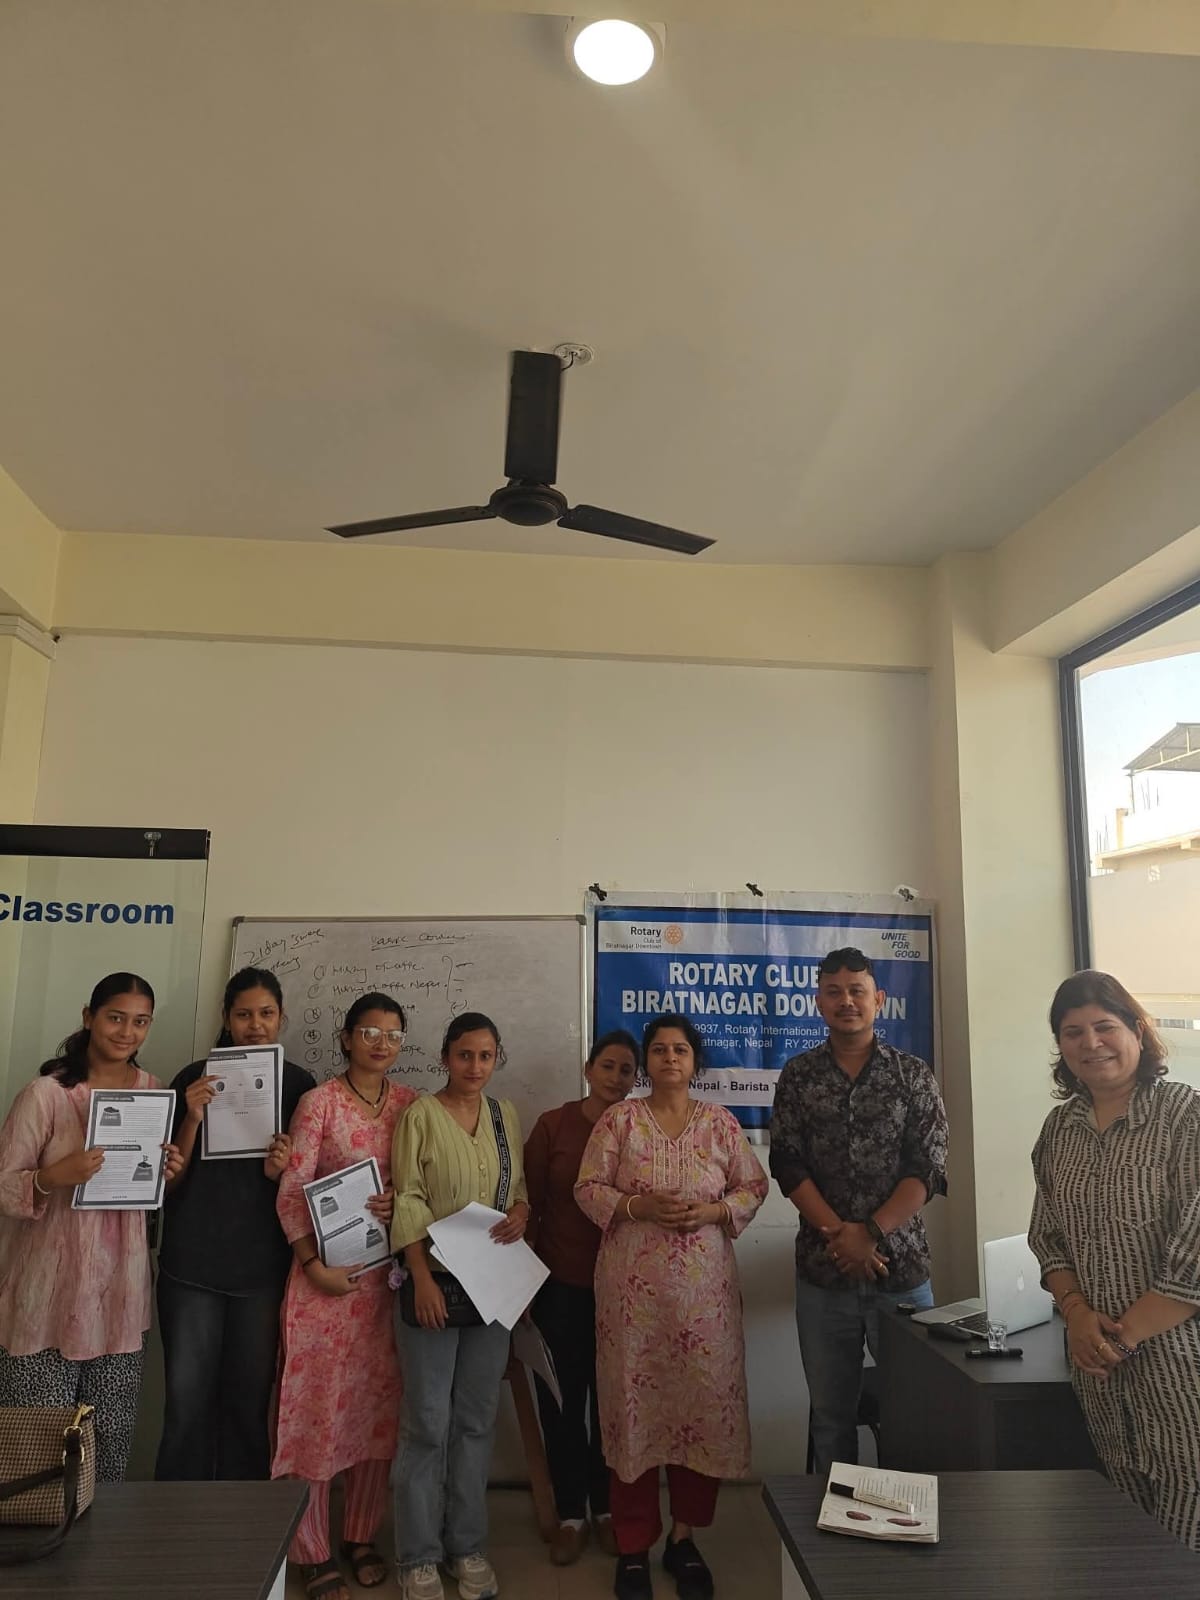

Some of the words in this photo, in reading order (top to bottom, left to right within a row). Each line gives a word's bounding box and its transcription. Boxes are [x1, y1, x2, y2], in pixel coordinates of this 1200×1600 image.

[0, 893, 174, 924] Classroom
[630, 926, 661, 937] Rotary
[881, 932, 907, 941] UNITE
[891, 941, 910, 949] FOR
[895, 950, 921, 958] GOOD
[669, 962, 758, 986] ROTARY
[622, 990, 768, 1015] BIRATNAGAR
[775, 993, 907, 1020] DOWWN
[724, 1024, 757, 1036] Rotary
[761, 1025, 820, 1037] International
[744, 1038, 773, 1050] Nepal
[785, 1039, 799, 1049] RY
[689, 1081, 720, 1093] Nepal
[731, 1081, 769, 1092] Barista
